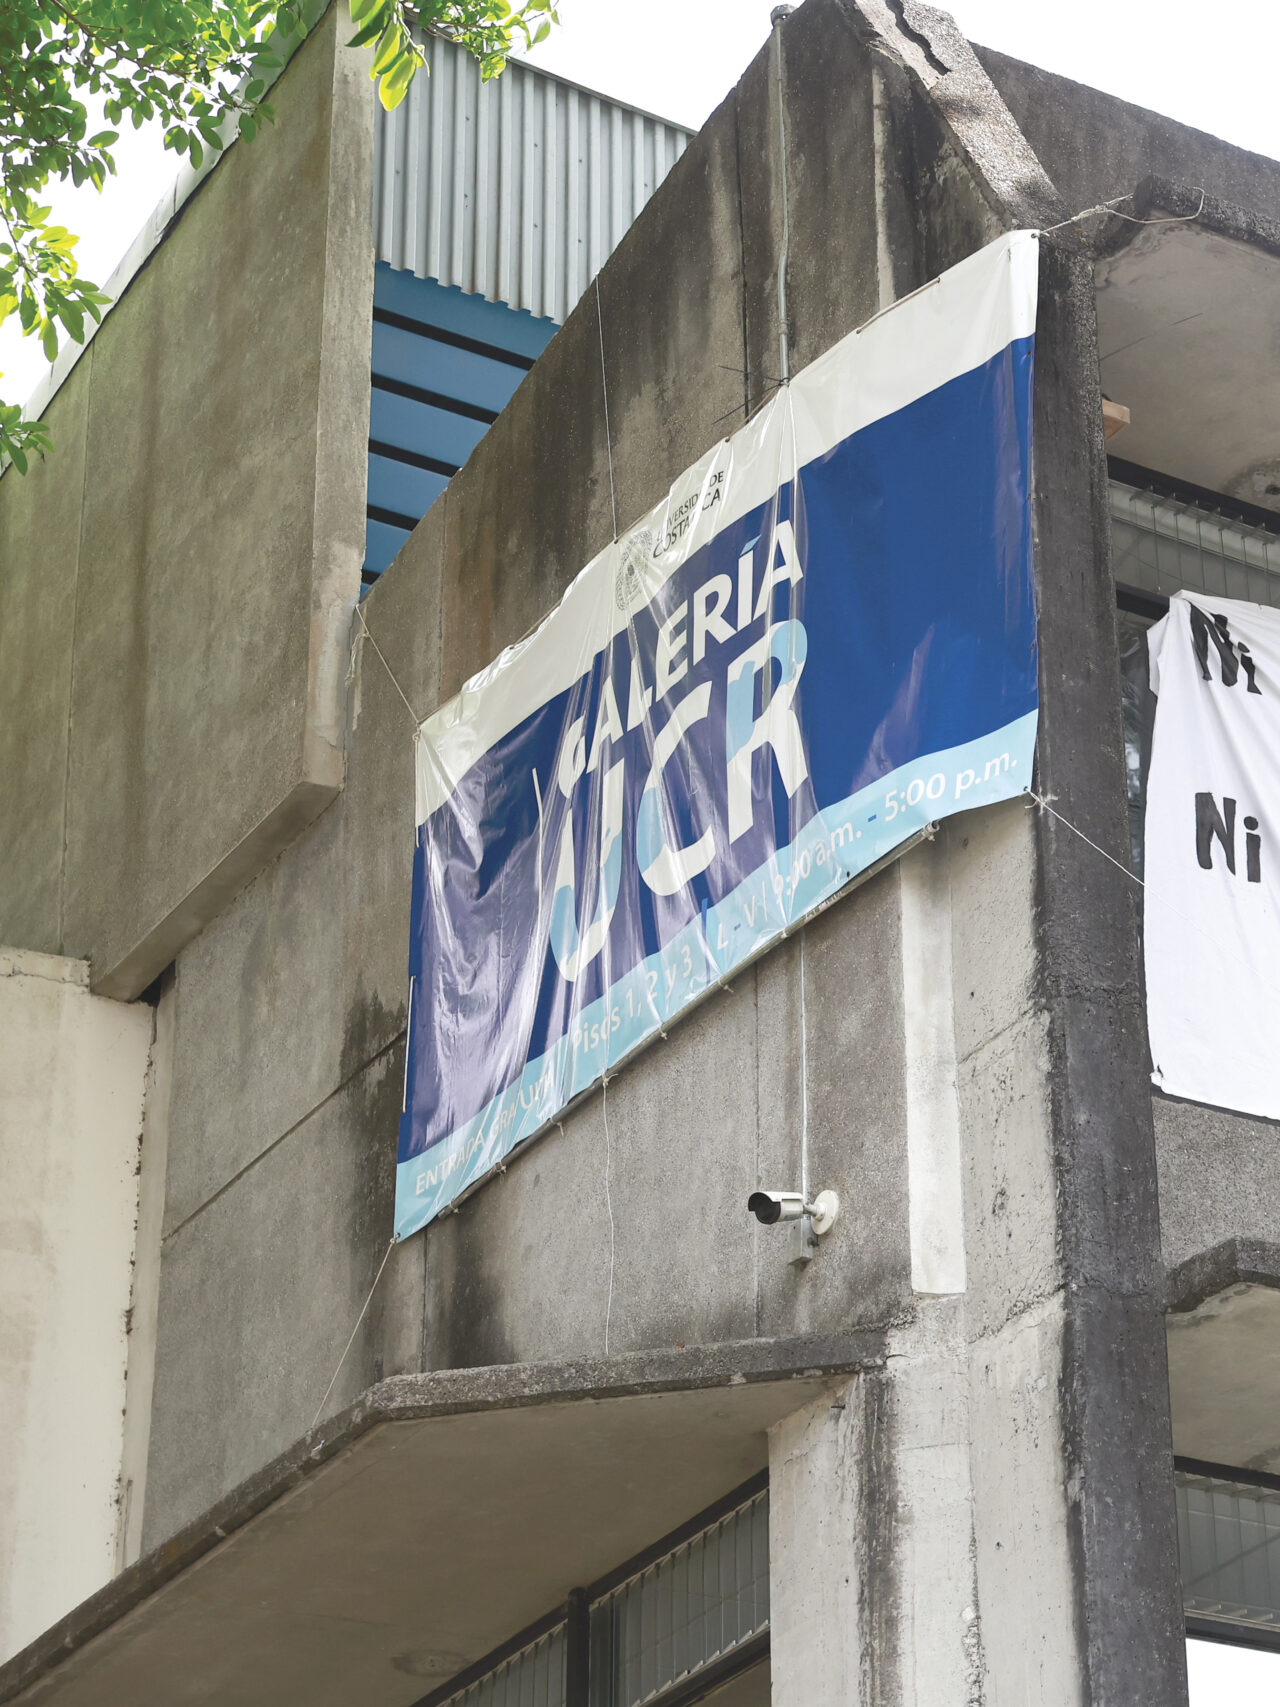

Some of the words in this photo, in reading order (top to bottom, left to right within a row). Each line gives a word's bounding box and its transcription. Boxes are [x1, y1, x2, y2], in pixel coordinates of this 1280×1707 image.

[709, 471, 724, 487] DE
[653, 513, 690, 558] COSTA
[558, 520, 803, 799] GALERÍA
[1188, 598, 1262, 695] Ni
[550, 619, 808, 982] UCR
[1195, 791, 1261, 883] Ni
[416, 1130, 486, 1195] ENTRADA
[573, 1007, 621, 1053] Pisos
[646, 971, 658, 998] 2
[681, 945, 692, 978] 3
[717, 922, 729, 950] L
[744, 895, 755, 928] V
[816, 822, 862, 867] a.m.
[884, 773, 946, 822] 5:00
[954, 753, 1018, 799] p.m.
